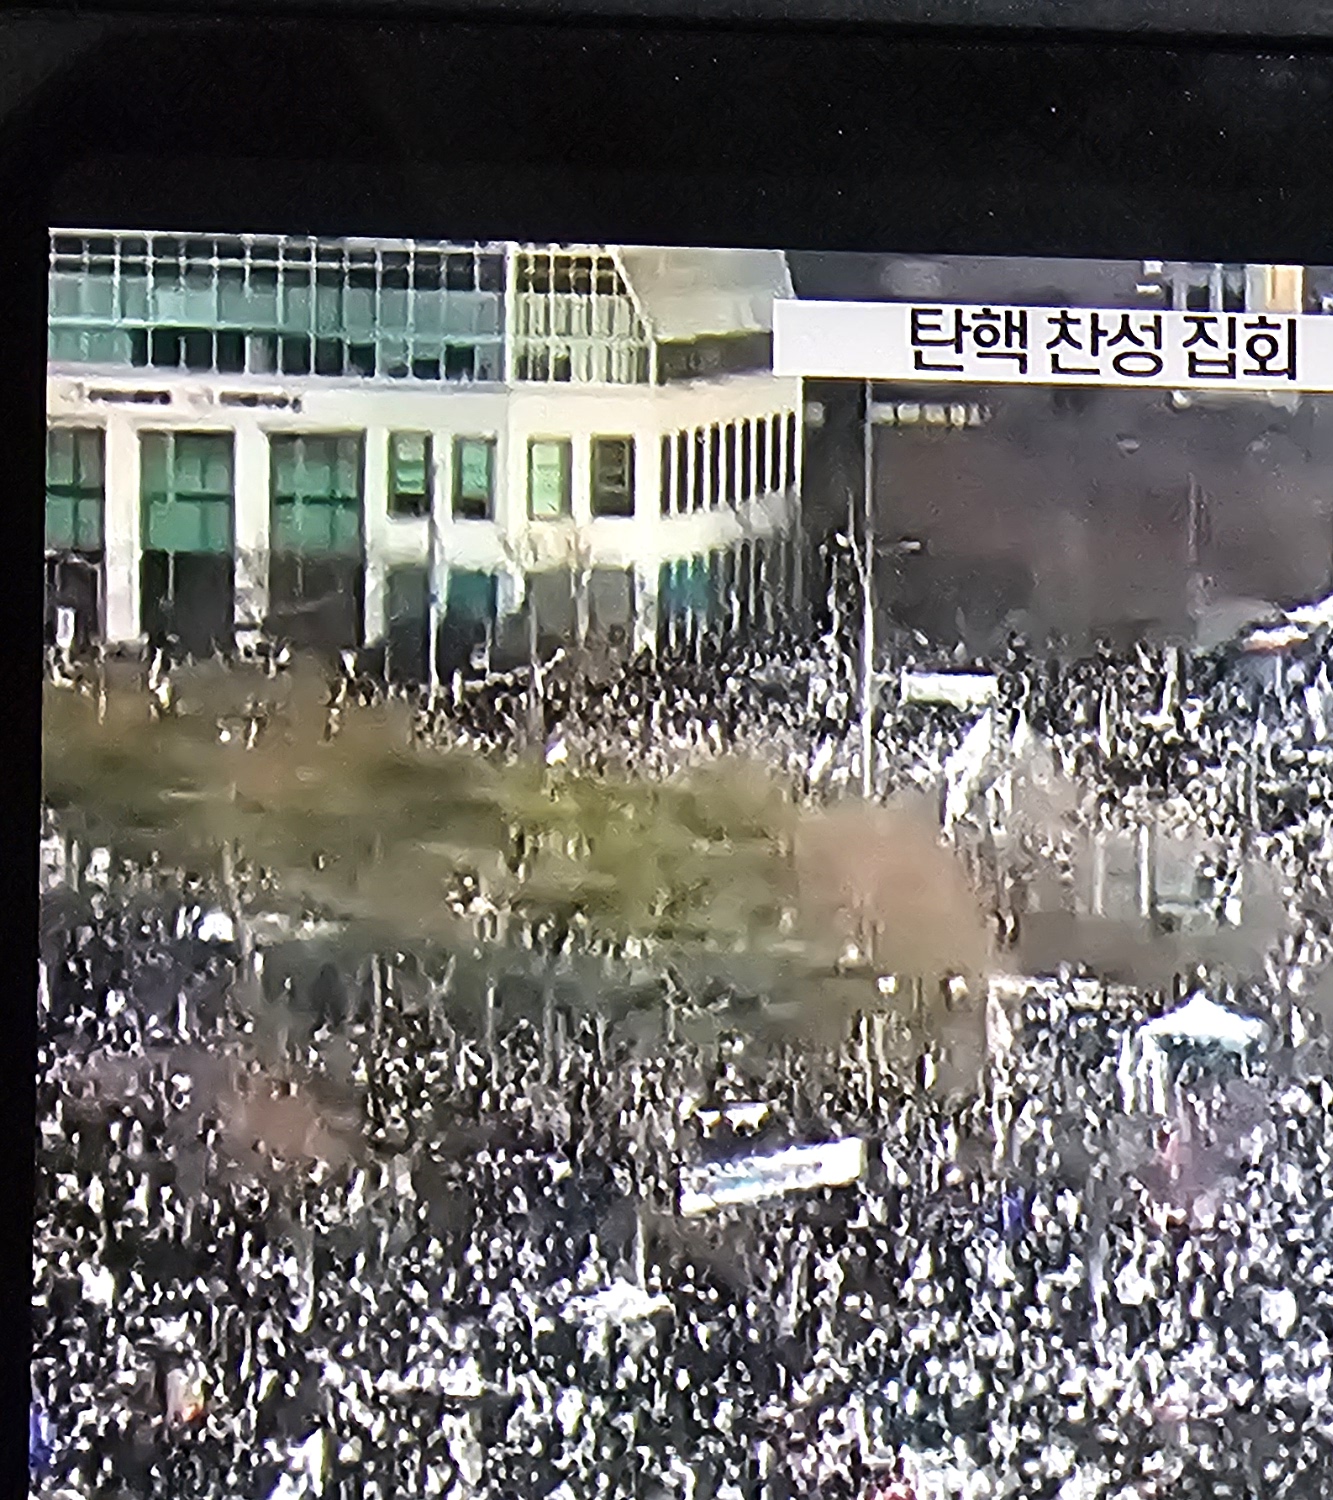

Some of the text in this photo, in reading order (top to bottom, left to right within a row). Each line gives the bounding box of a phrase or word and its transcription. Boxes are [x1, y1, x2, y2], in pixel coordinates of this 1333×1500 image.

[909, 308, 1297, 381] 탄핵 찬성 집회
